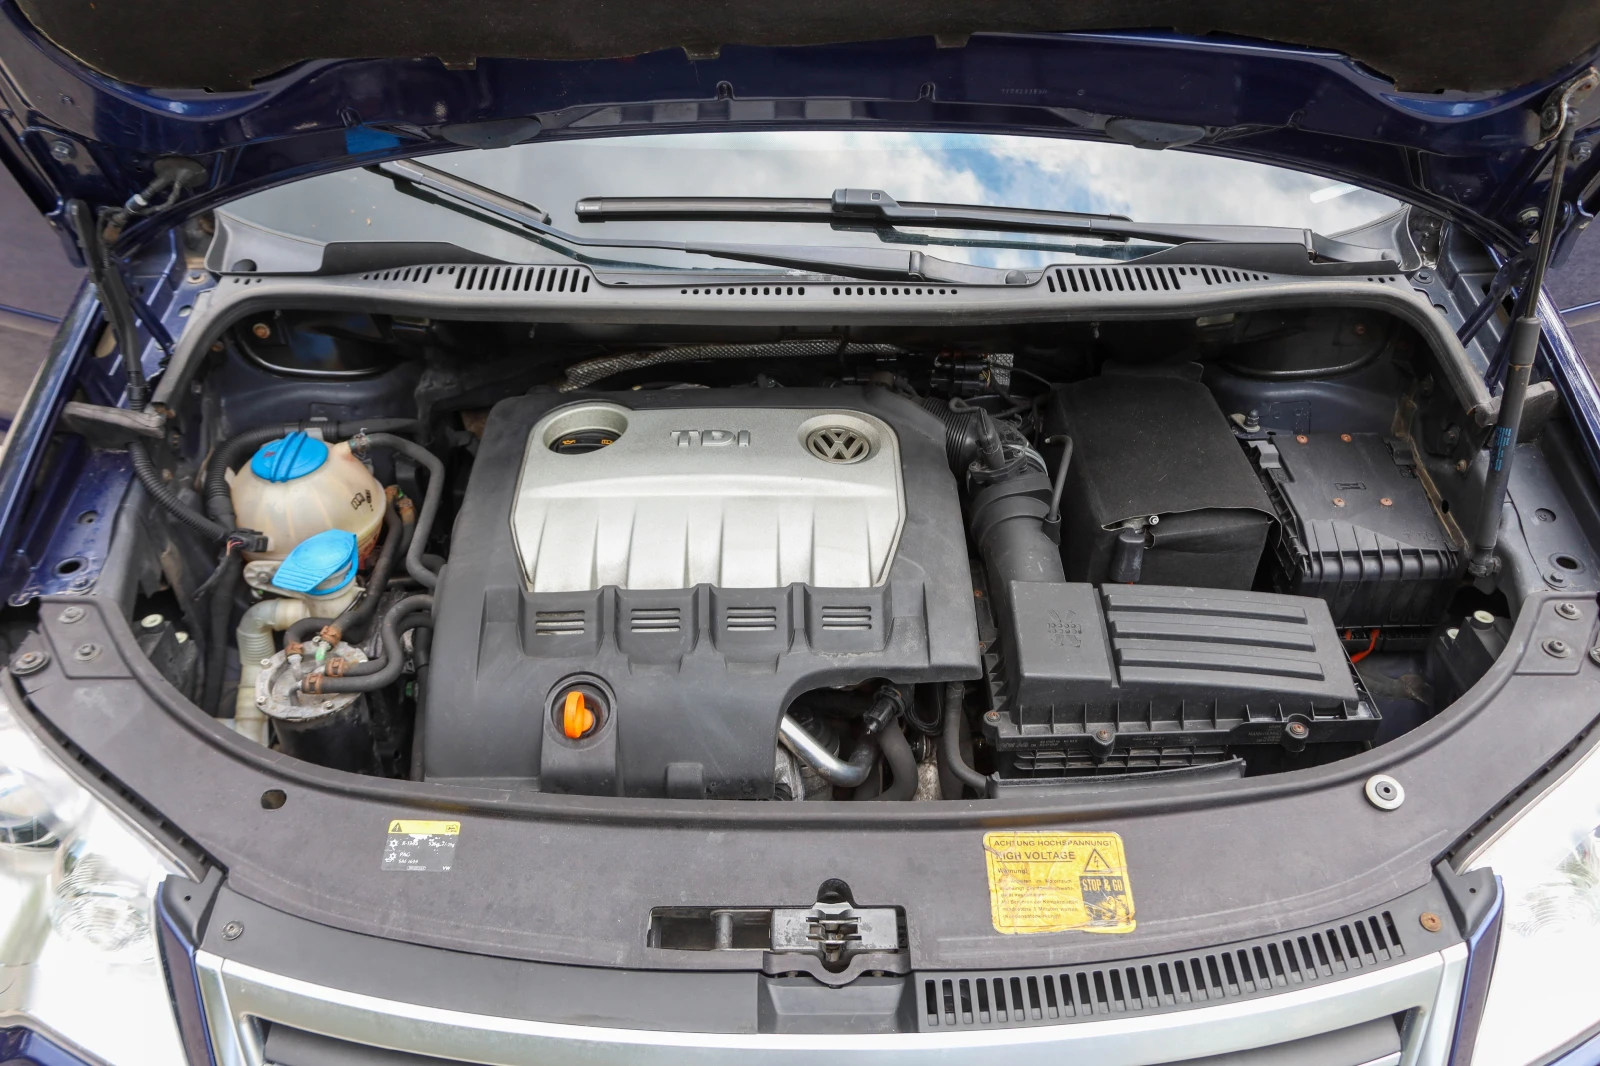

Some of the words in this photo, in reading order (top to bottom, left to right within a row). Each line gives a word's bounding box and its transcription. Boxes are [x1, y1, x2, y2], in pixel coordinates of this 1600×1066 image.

[670, 430, 749, 447] TDI
[806, 425, 871, 464] VW
[1024, 851, 1076, 860] VOLTAGE
[1082, 878, 1102, 891] STOP
[1104, 879, 1111, 891] &
[1112, 879, 1123, 891] GO
